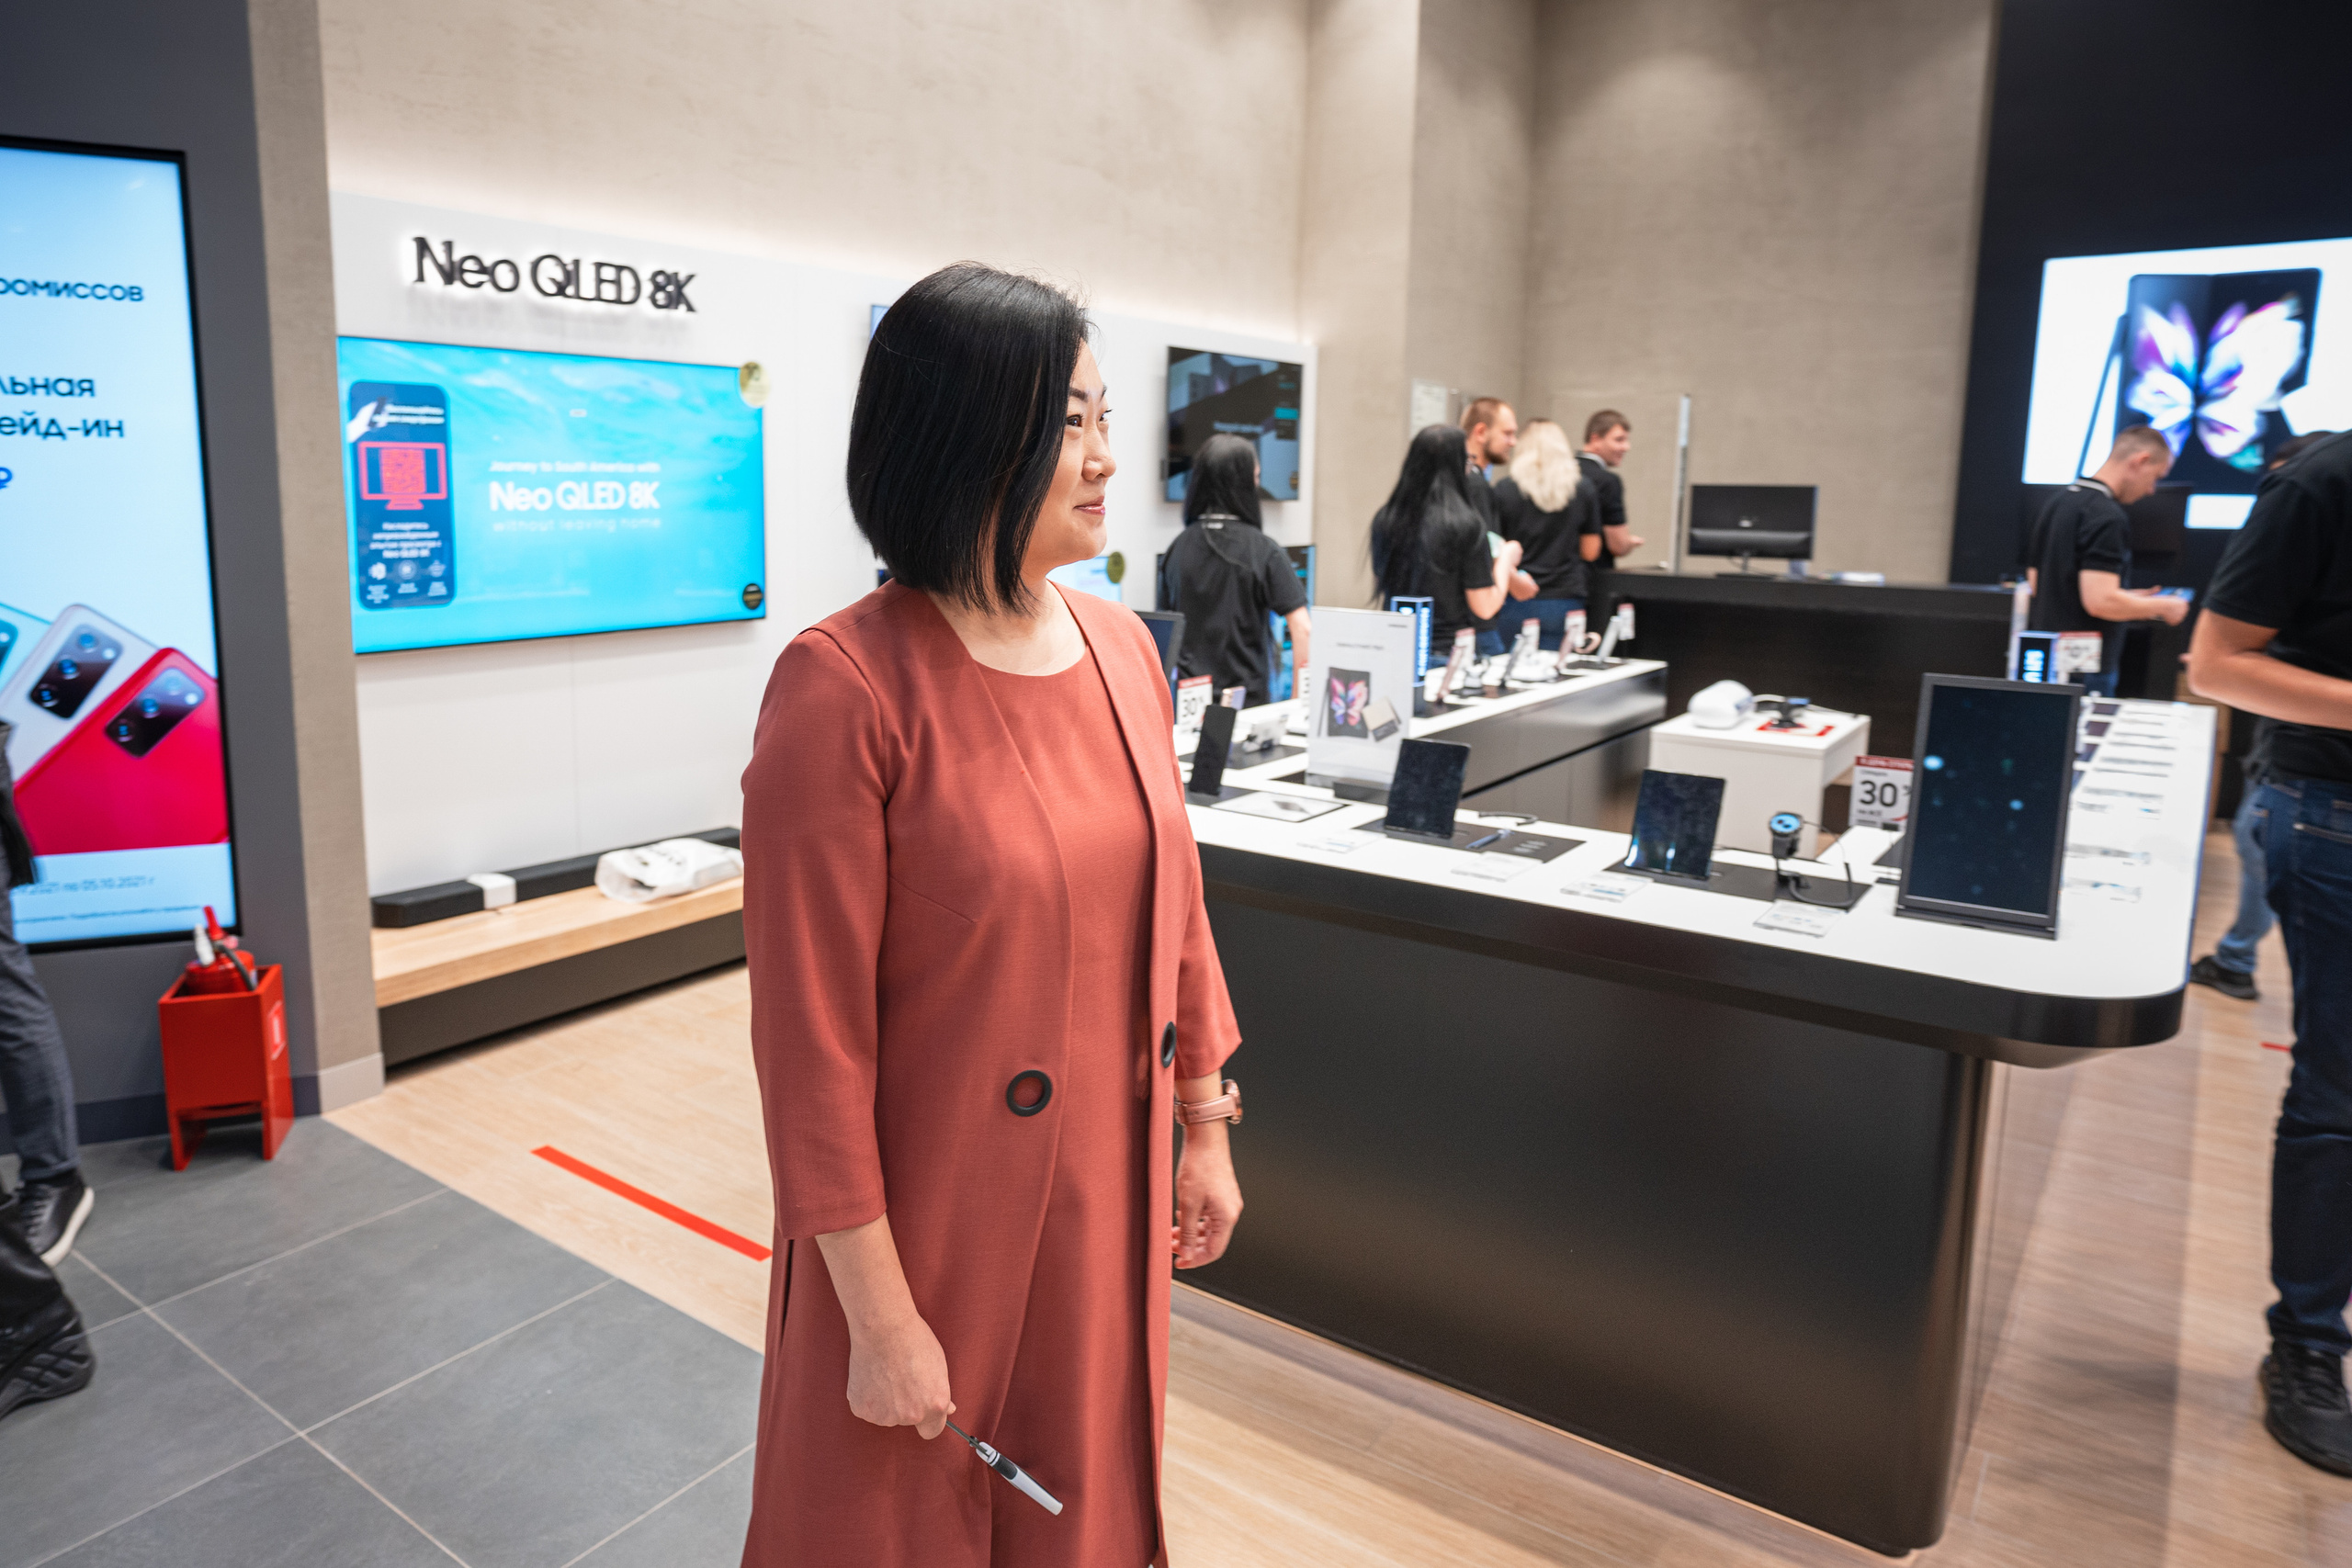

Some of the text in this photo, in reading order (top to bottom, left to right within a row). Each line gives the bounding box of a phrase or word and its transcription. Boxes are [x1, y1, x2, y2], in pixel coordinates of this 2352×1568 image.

[413, 236, 696, 313] Neo QLED 8K
[490, 480, 662, 512] Neo QLED 8K
